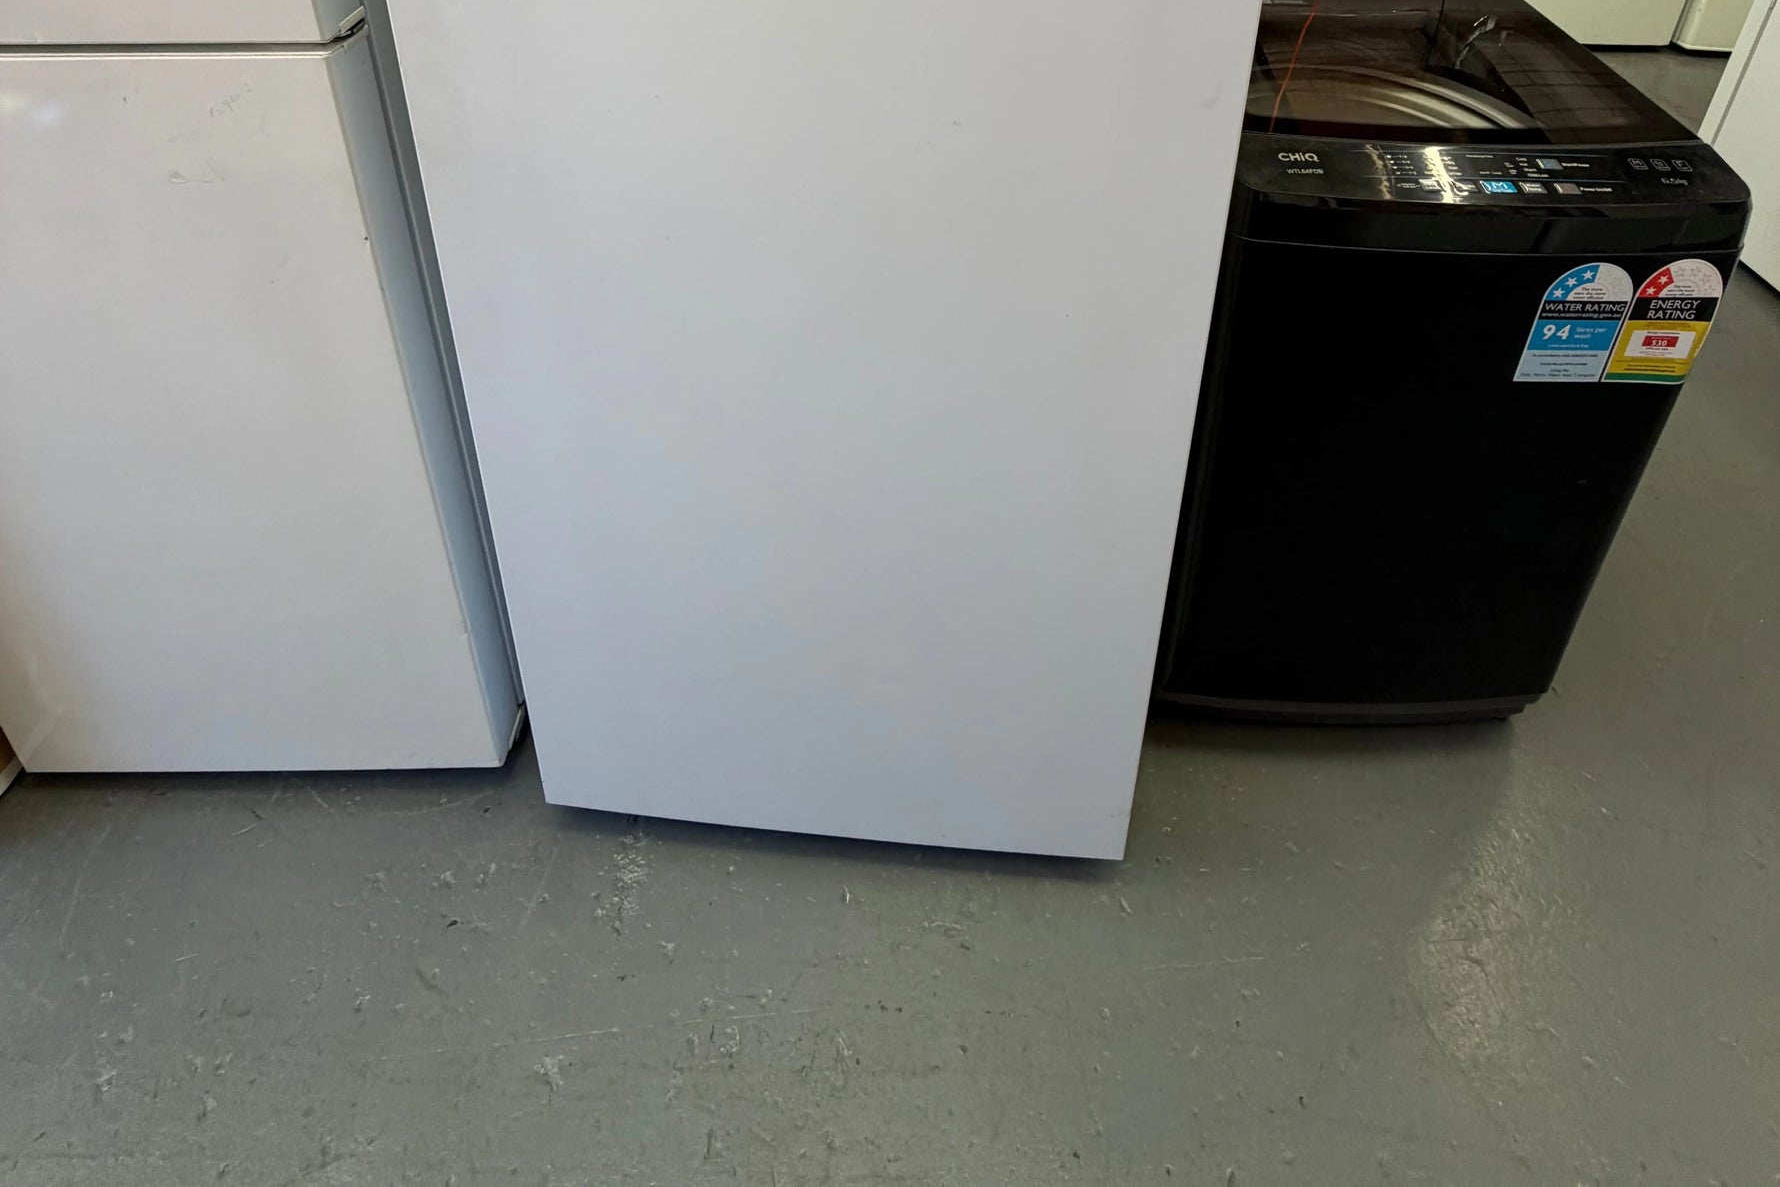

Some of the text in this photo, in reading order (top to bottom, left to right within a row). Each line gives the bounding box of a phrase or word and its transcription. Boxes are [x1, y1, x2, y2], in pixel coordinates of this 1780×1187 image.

[1545, 303, 1626, 312] WATER RATING
[1649, 299, 1701, 309] ENERGY
[1646, 310, 1696, 320] RATING
[1542, 324, 1572, 340] 94
